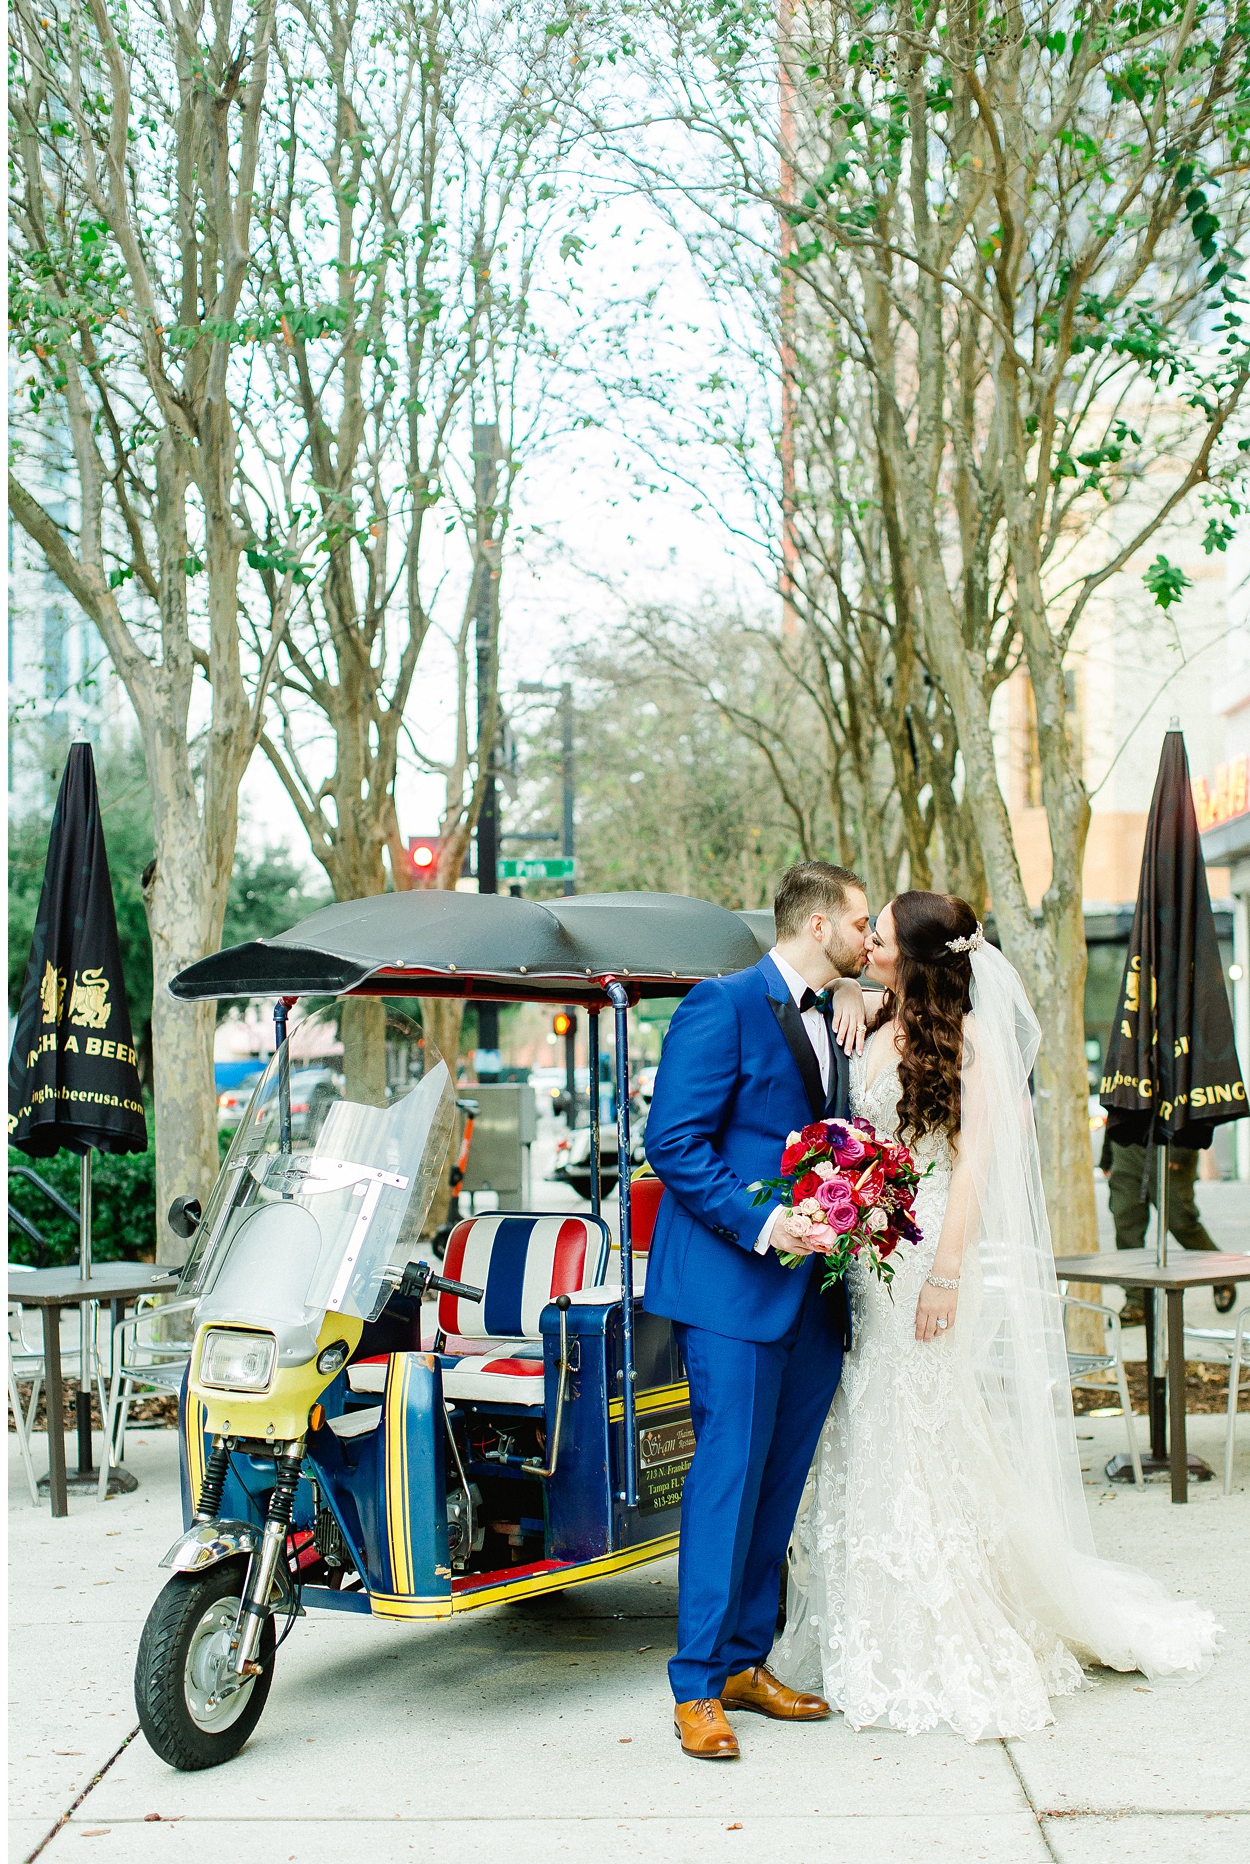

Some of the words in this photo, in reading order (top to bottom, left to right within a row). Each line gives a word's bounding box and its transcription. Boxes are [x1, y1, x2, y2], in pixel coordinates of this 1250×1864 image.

[84, 1037, 138, 1067] BEER
[646, 1468, 658, 1481] 713
[659, 1466, 666, 1478] N.
[648, 1482, 670, 1495] Tampa
